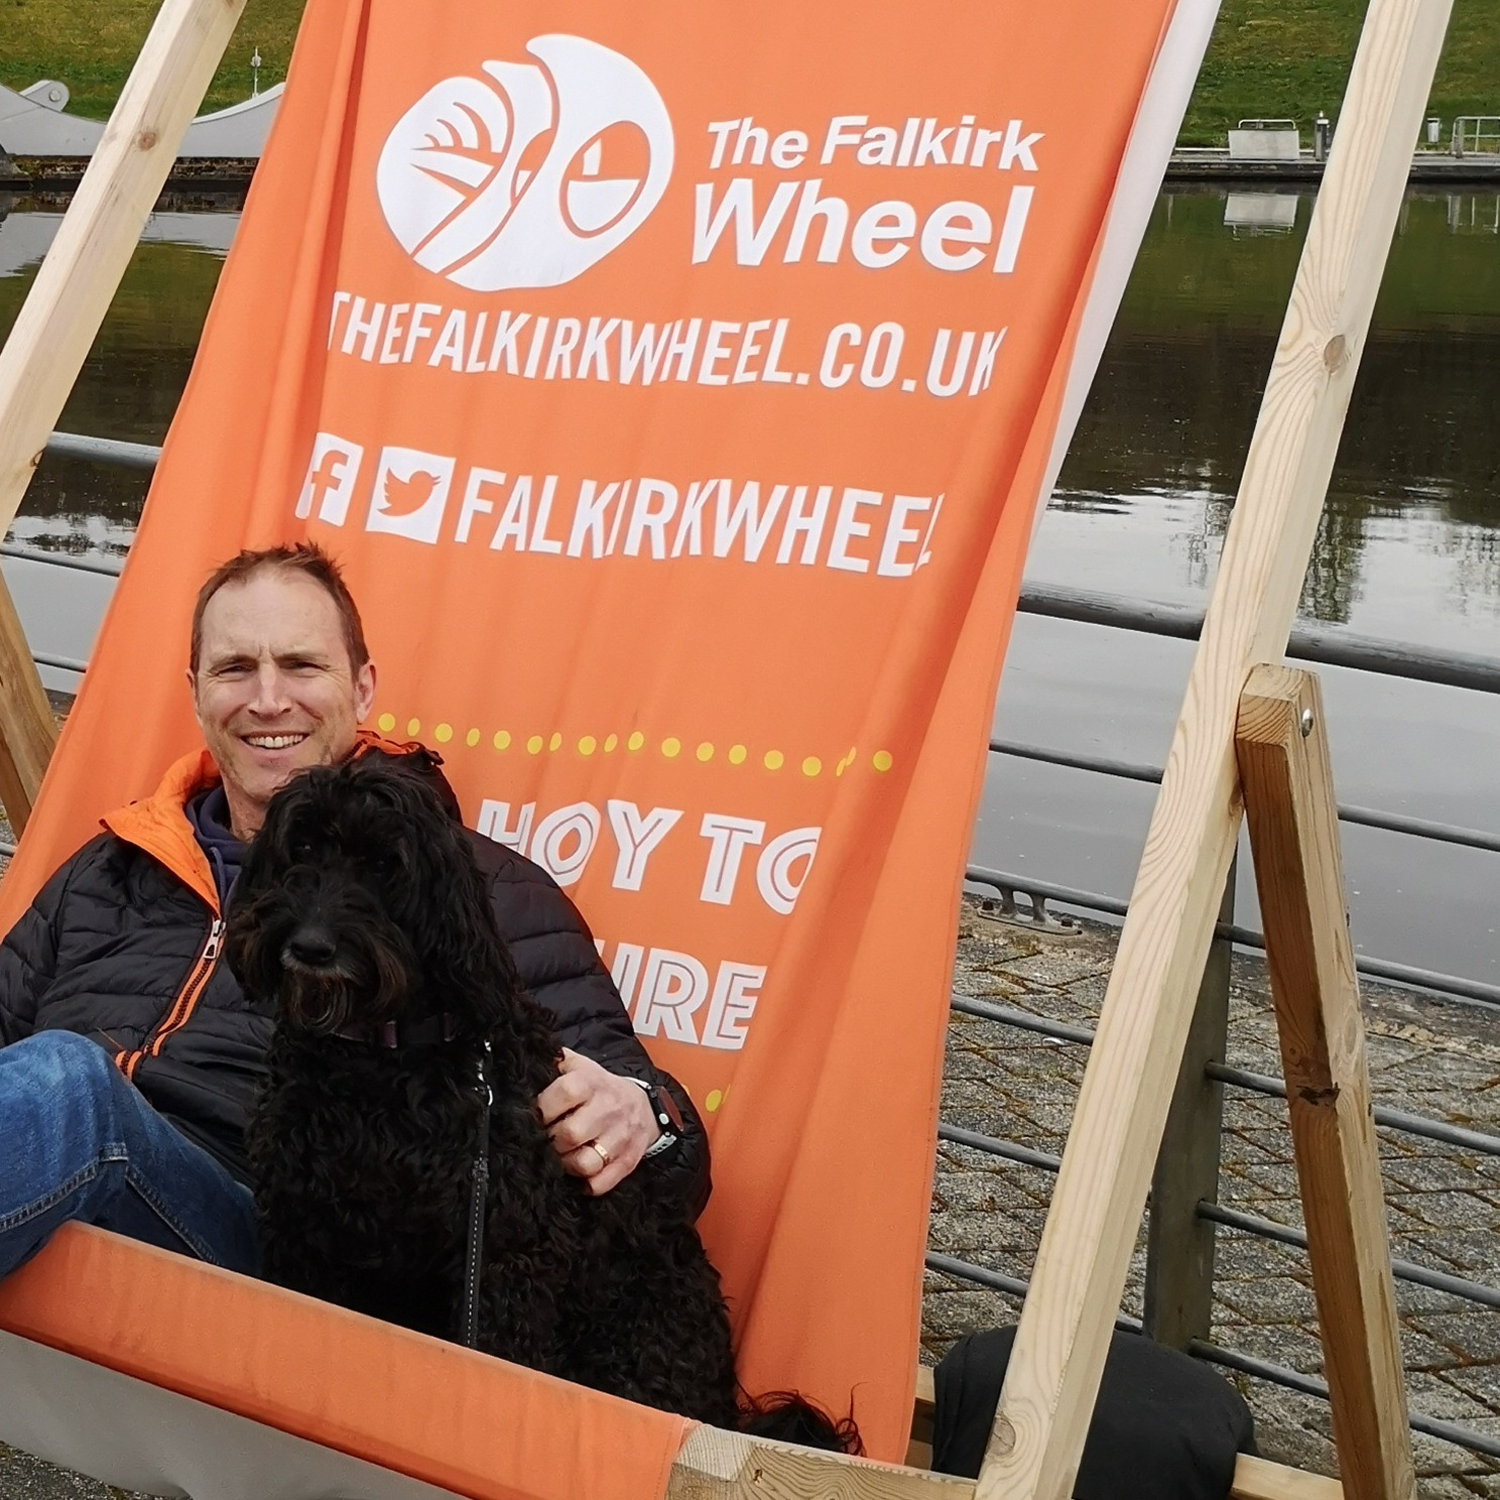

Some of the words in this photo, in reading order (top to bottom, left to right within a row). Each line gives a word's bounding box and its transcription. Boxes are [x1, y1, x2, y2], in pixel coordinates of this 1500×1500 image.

[706, 116, 808, 169] The
[820, 114, 1048, 171] Falkirk
[691, 178, 1035, 274] Wheel
[327, 290, 1008, 397] THEFALKIRKWHEEL.CO.UK
[454, 466, 946, 578] FALKIRKWHEEL
[476, 798, 685, 892] HOY
[699, 813, 822, 915] TO
[595, 938, 768, 1050] IRE
